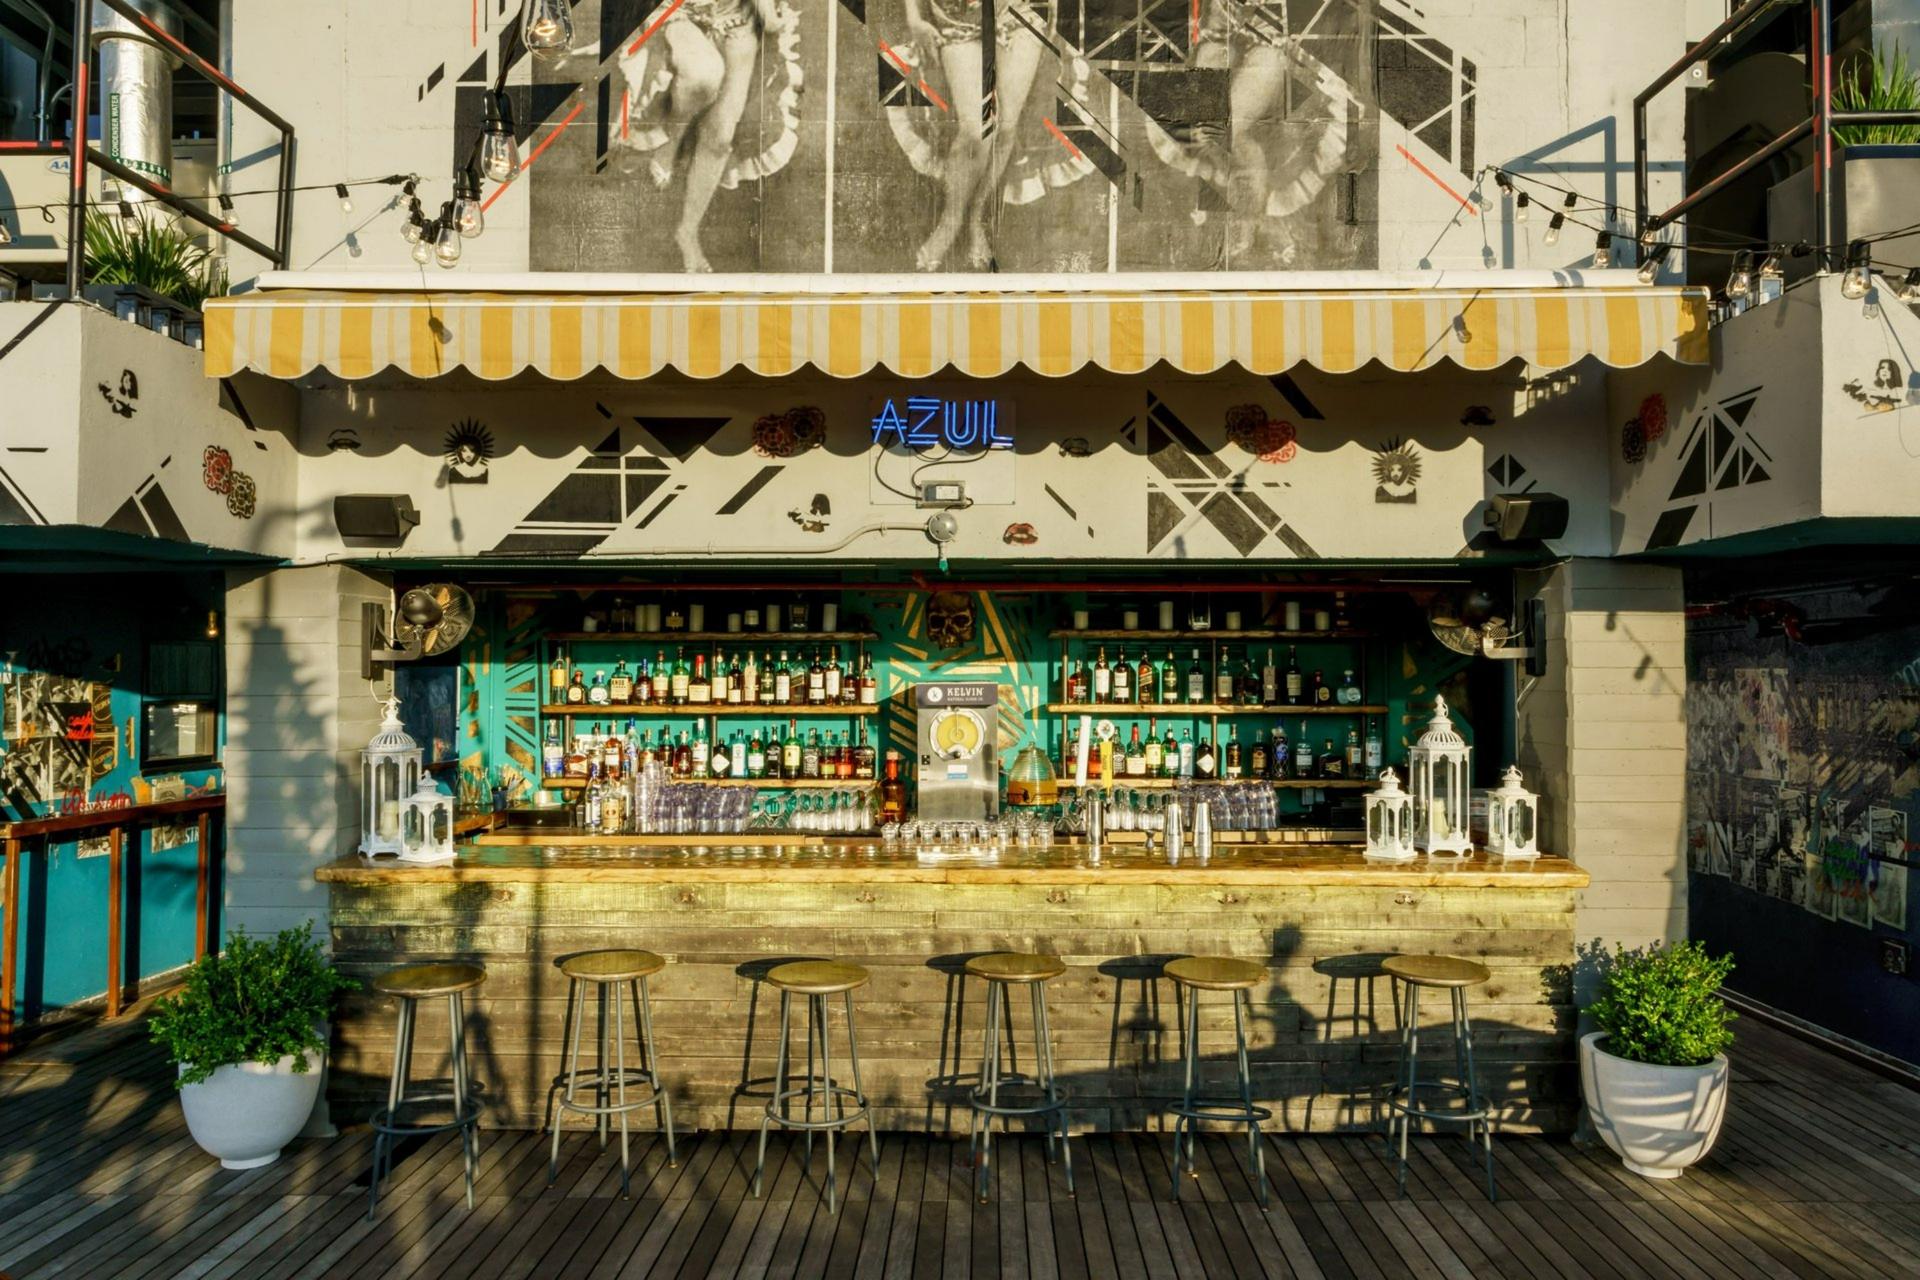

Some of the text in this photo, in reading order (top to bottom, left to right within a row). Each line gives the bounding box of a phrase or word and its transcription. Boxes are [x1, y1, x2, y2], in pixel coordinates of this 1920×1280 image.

[111, 94, 119, 157] CONDENSER WATER
[50, 160, 70, 170] AA
[871, 397, 1014, 446] AZUL
[947, 687, 984, 697] KELVIN
